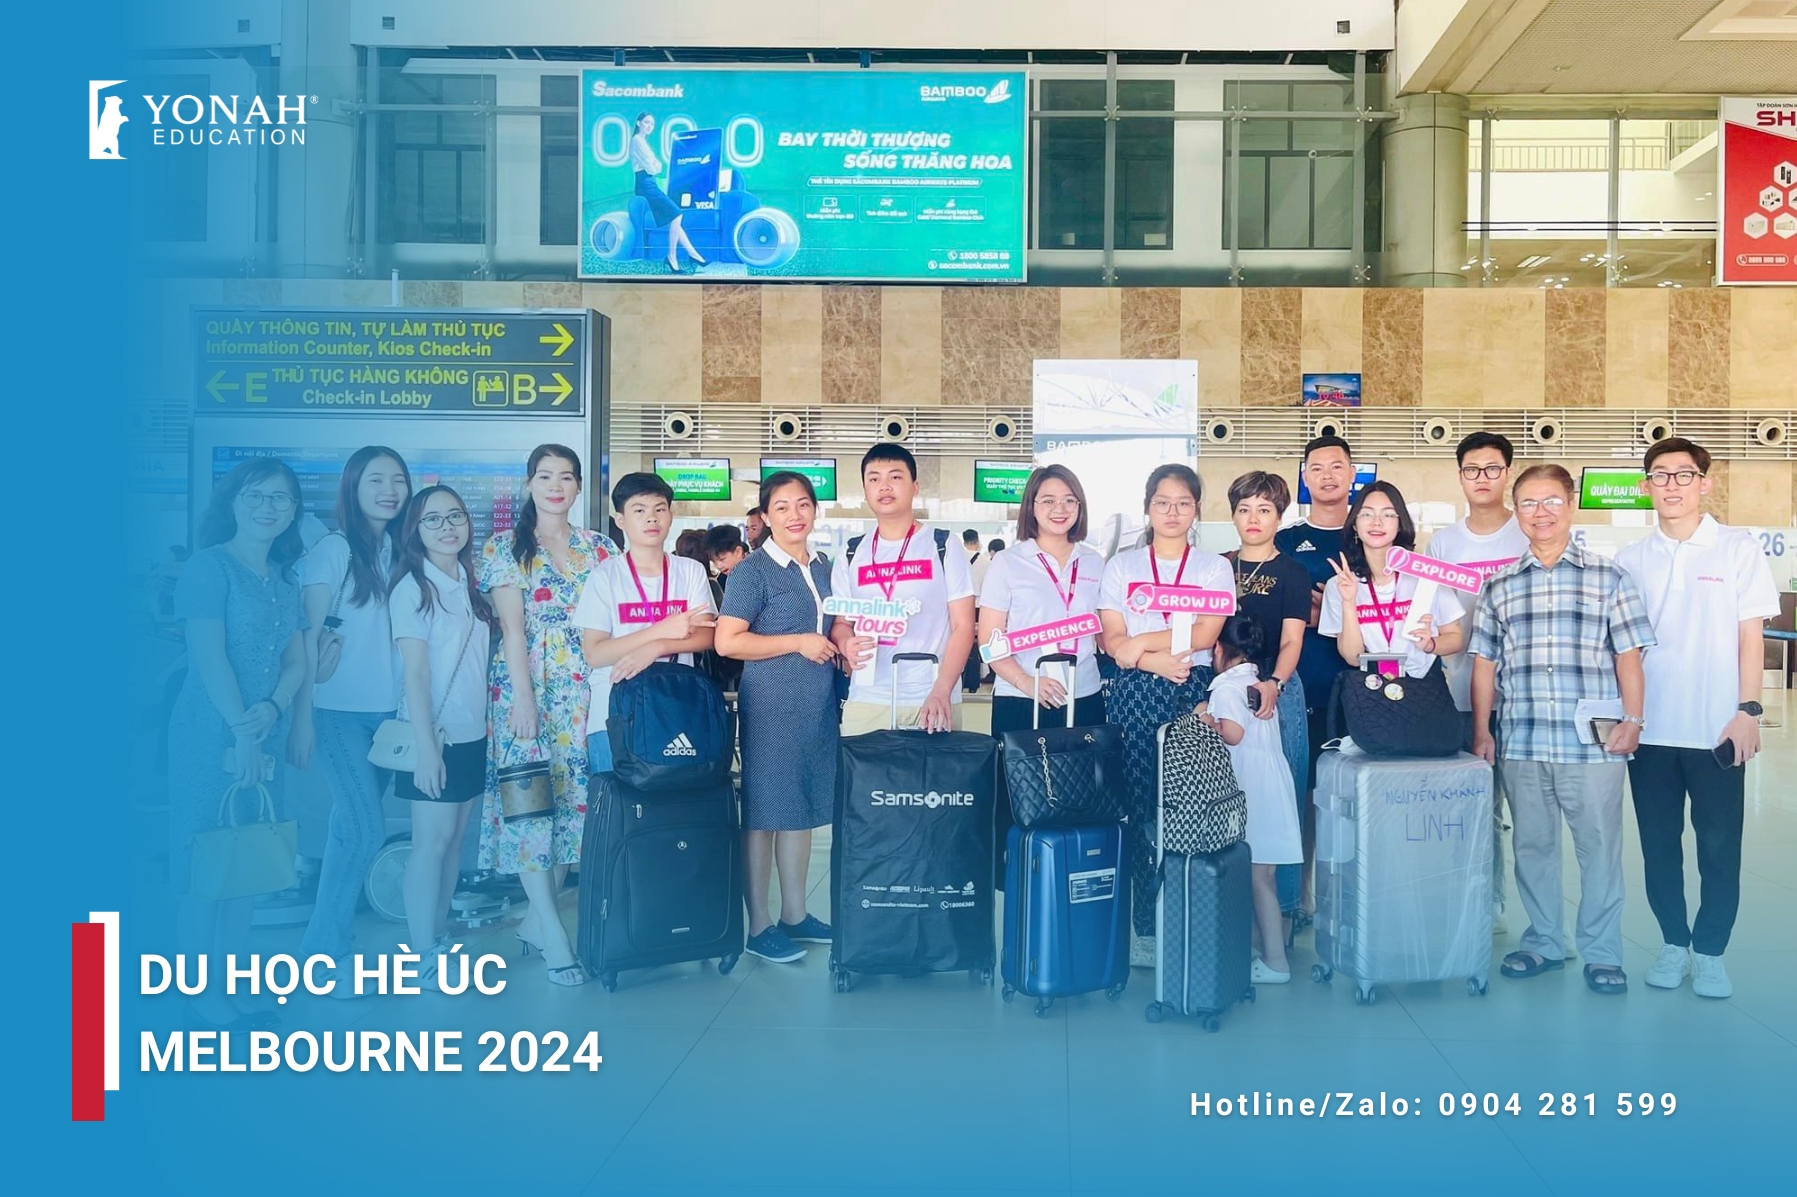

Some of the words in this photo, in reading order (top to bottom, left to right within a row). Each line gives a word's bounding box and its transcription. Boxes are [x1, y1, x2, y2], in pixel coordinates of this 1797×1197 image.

[592, 80, 684, 98] Sacombank
[920, 86, 987, 98] BAMBOO
[778, 132, 819, 147] BAY
[822, 129, 866, 148] THỜI
[871, 131, 951, 151] THƯỢNG
[843, 150, 898, 170] SỐNG
[901, 152, 967, 170] THĂNG
[970, 155, 1013, 170] HOA
[694, 201, 715, 210] VISA
[938, 262, 1010, 270] sacombank.com.vn
[259, 318, 320, 336] THÔNG
[324, 322, 356, 338] TIN,
[361, 322, 386, 339] TỰ
[390, 319, 426, 336] LÀM
[432, 319, 466, 337] THỦ
[471, 322, 506, 340] TỤC
[206, 340, 299, 355] Information
[304, 340, 373, 358] Counter,
[378, 340, 414, 356] Kios
[419, 341, 492, 357] Check-in
[272, 365, 305, 383] THỦ
[309, 368, 344, 386] TỤC
[349, 365, 400, 384] HÀNG
[405, 366, 469, 385] KHÔNG
[245, 372, 268, 403] E
[513, 374, 537, 406] B
[302, 388, 376, 406] Check-in
[380, 389, 432, 408] Lobby
[1411, 560, 1476, 588] EXPLORE
[824, 598, 906, 618] annalink
[1158, 594, 1206, 609] GROW
[1209, 597, 1230, 610] UP
[852, 615, 906, 635] tours
[1012, 620, 1096, 648] EXPERIENCE
[662, 747, 696, 757] adidas
[870, 790, 974, 809] Samsonite
[1405, 814, 1464, 842] LINH
